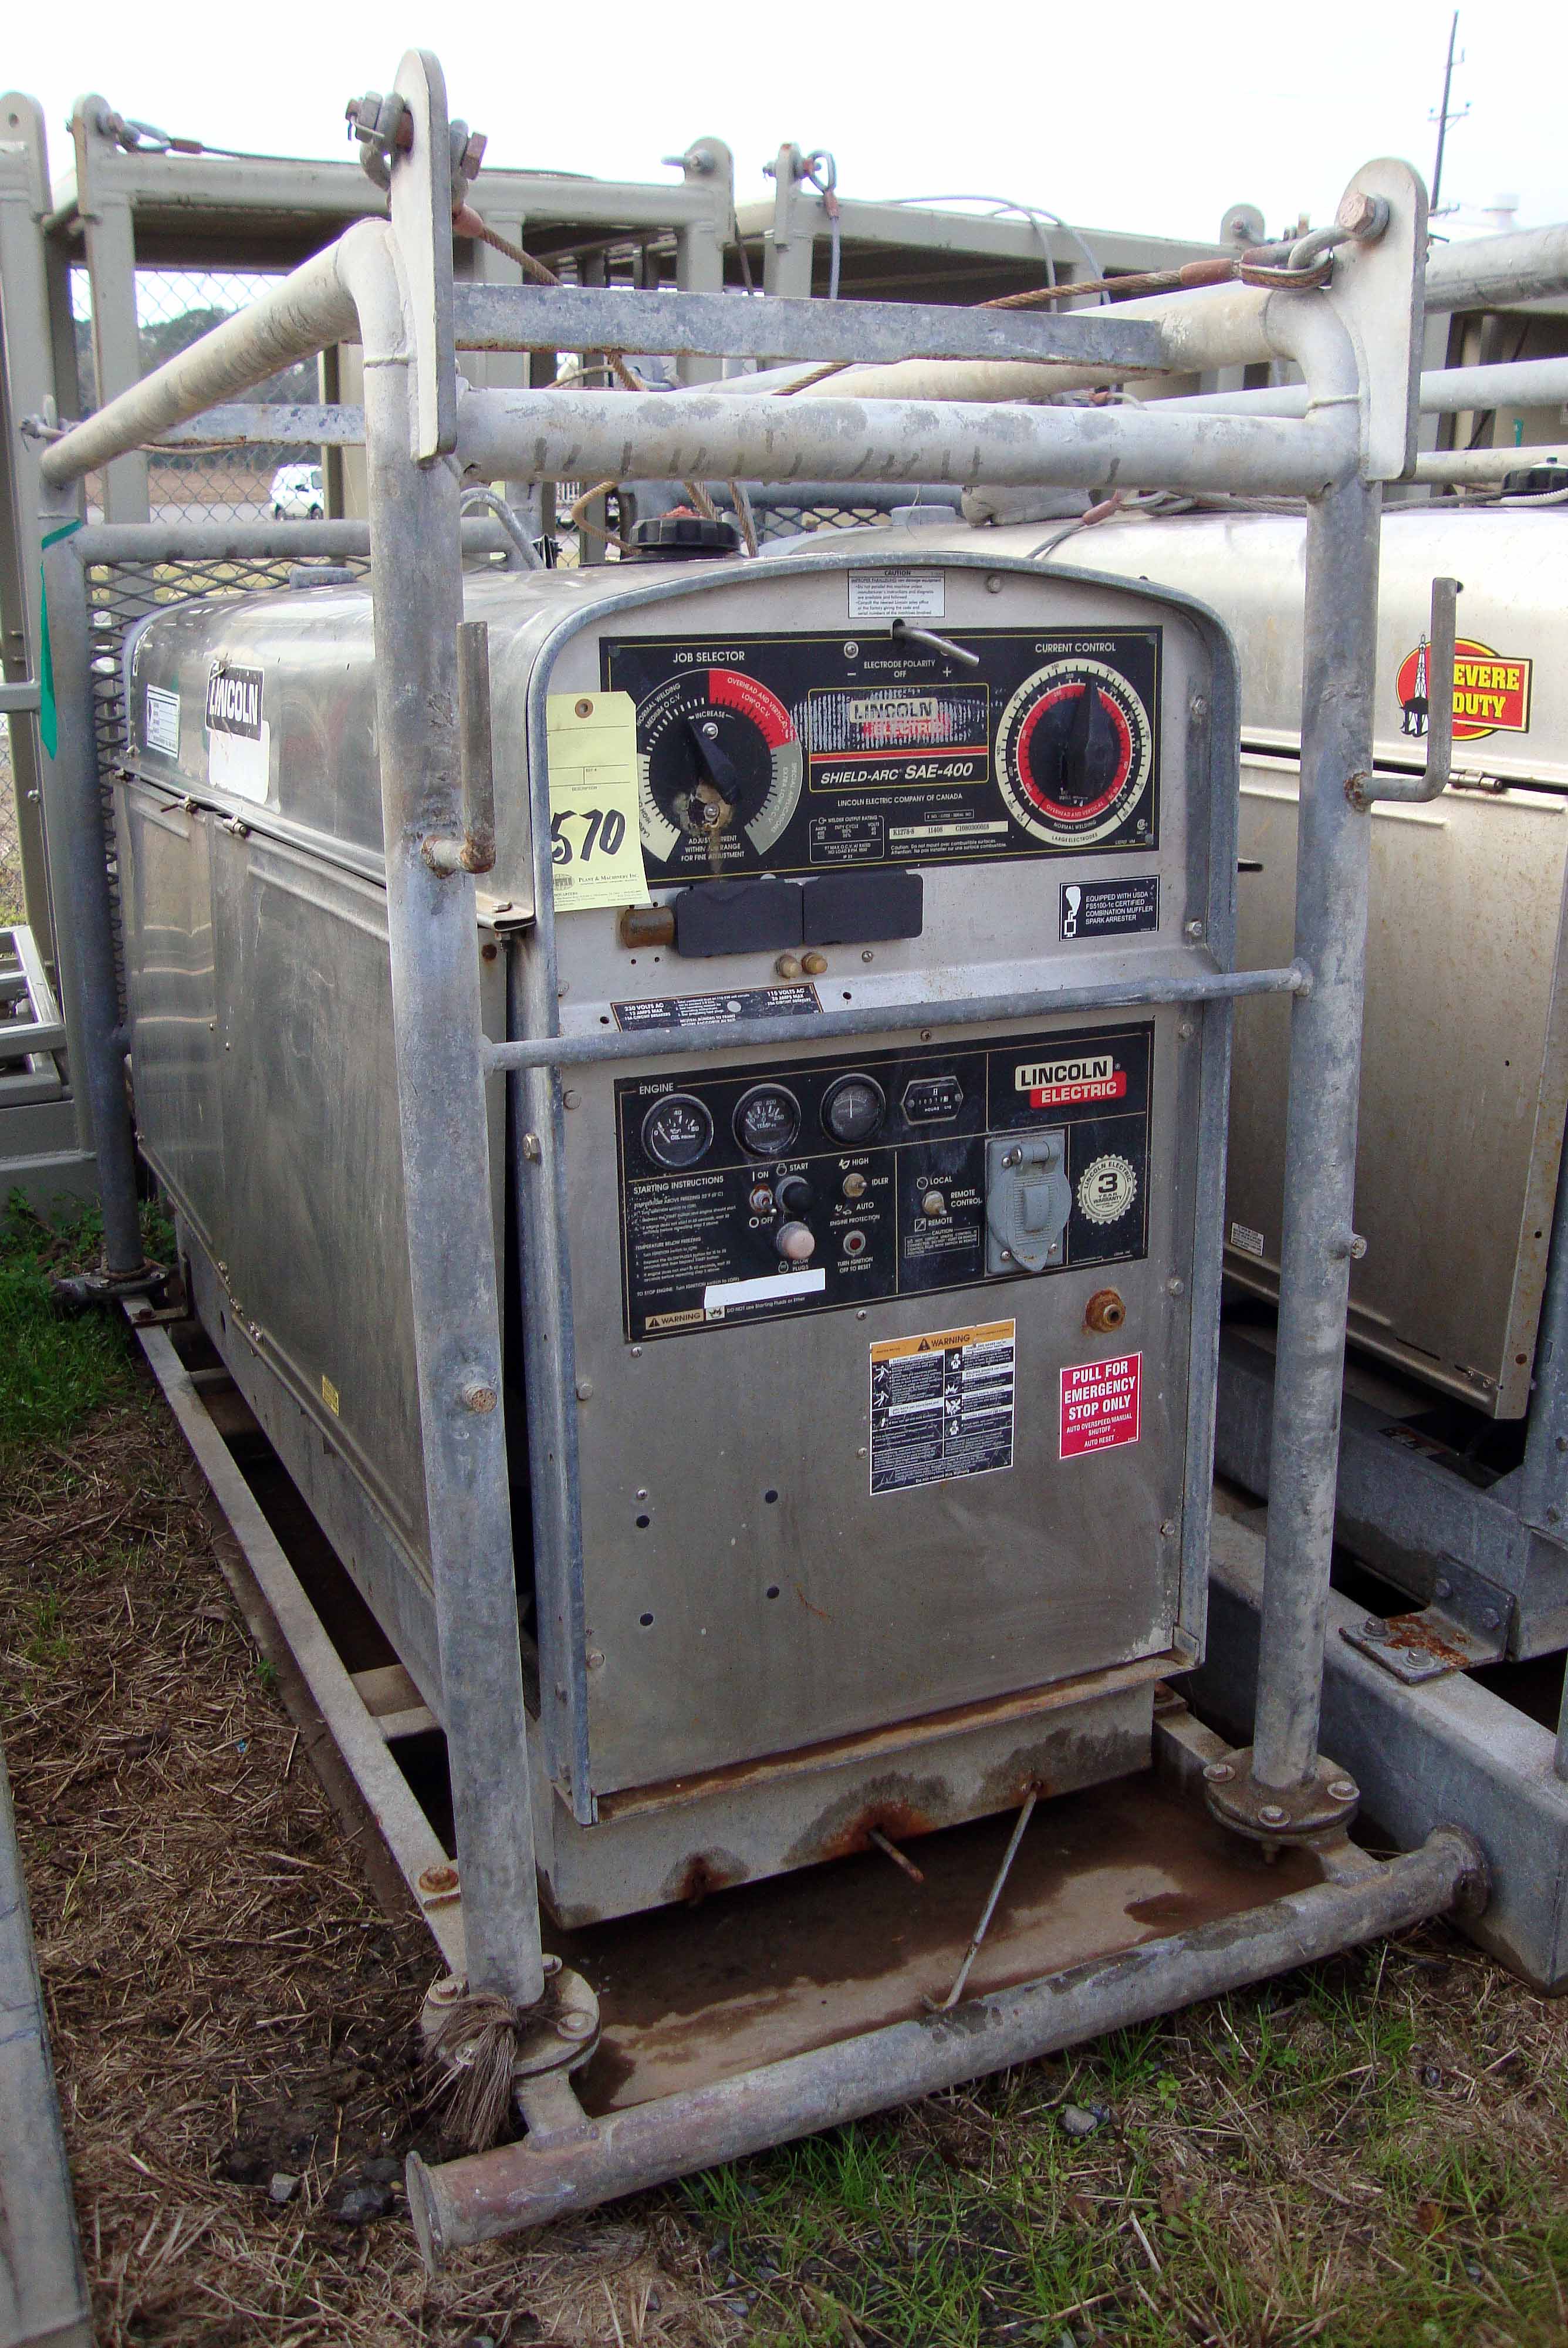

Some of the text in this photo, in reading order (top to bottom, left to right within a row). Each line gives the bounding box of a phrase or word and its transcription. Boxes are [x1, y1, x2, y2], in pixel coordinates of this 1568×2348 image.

[1035, 642, 1116, 653] CURRENT CONTROL
[673, 651, 745, 663] JOB SELECTOR
[864, 660, 935, 669] ELECTRODE POLARITY
[1454, 664, 1520, 691] EVERE
[728, 677, 758, 694] OVERHEAD
[758, 692, 769, 703] AND
[209, 677, 258, 725] LINCOLN
[637, 683, 681, 727] NORMAL WELDING
[1453, 692, 1506, 718] DUTY
[695, 710, 725, 718] INCREASE
[904, 762, 974, 780] SAE-400
[837, 799, 864, 807] LINCOLN
[866, 798, 893, 806] ELECTRIC
[894, 796, 925, 804] COMPANY
[935, 793, 962, 801] CANADA
[1046, 804, 1070, 818] OVERHEAD
[1053, 820, 1096, 830] NORMAL WELDING
[551, 809, 626, 865] 570
[1086, 894, 1115, 902] EQUIPPED
[1115, 899, 1144, 907] CERTIFIED
[1086, 905, 1153, 917] COMBINATION MUFFLER
[1086, 914, 1136, 925] SPARK ARRESTER
[1021, 1060, 1107, 1086] LINCOLN
[640, 1083, 674, 1094] ENGINE
[1042, 1081, 1117, 1104] ELECTRIC
[789, 1162, 809, 1172] START
[852, 1158, 869, 1166] HIGH
[930, 1176, 952, 1185] LOCAL
[1084, 1161, 1132, 1189] LINCOLN ELECTRIC
[633, 1176, 724, 1195] STARTING INSTRUCTIONS
[871, 1178, 888, 1186] IDLER
[1098, 1173, 1118, 1193] 3
[951, 1189, 975, 1199] REMOTE
[951, 1197, 982, 1207] CONTROL
[1093, 1196, 1121, 1204] WARRANTY
[856, 1202, 874, 1210] AUTO
[849, 1215, 880, 1223] PROTECTION
[928, 1217, 953, 1226] REMOTE
[850, 1256, 873, 1265] IGNITION
[755, 1301, 773, 1310] Starting
[661, 1313, 701, 1324] WARNING
[931, 1334, 970, 1347] WARNING
[1073, 1361, 1128, 1385] PULL FOR
[1065, 1375, 1136, 1405] EMERGENCY
[1069, 1394, 1131, 1421] STOP ONLY
[1066, 1412, 1132, 1433] AUTO OVERSPEED/MANUAL
[1089, 1425, 1111, 1436] SHUTOFF
[1084, 1435, 1114, 1448] AUTO RESET
